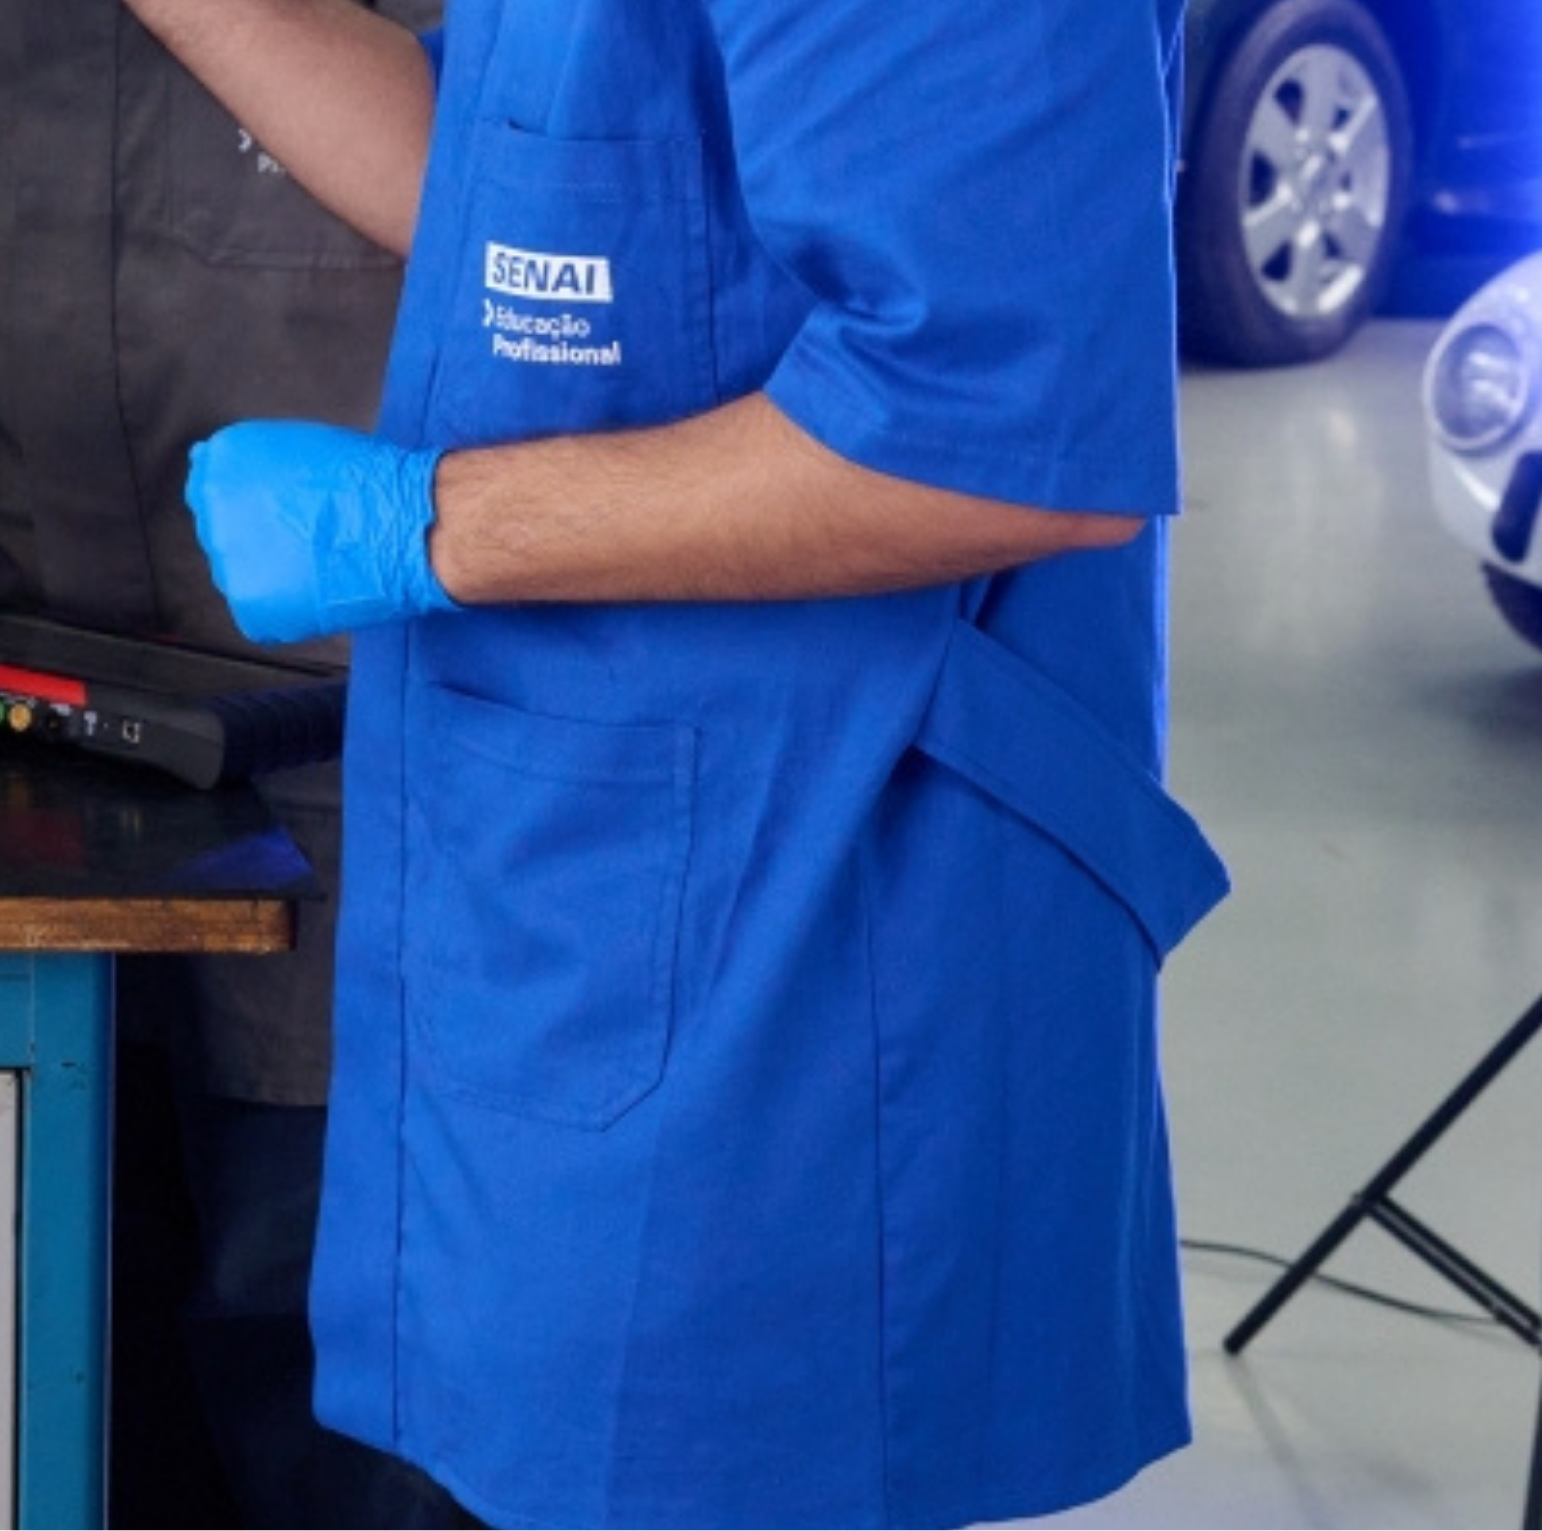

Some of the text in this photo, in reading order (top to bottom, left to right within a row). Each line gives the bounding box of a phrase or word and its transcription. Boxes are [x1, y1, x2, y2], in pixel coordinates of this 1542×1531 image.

[492, 250, 598, 296] SENAI
[496, 305, 591, 339] Educação
[492, 334, 622, 365] Profissional
